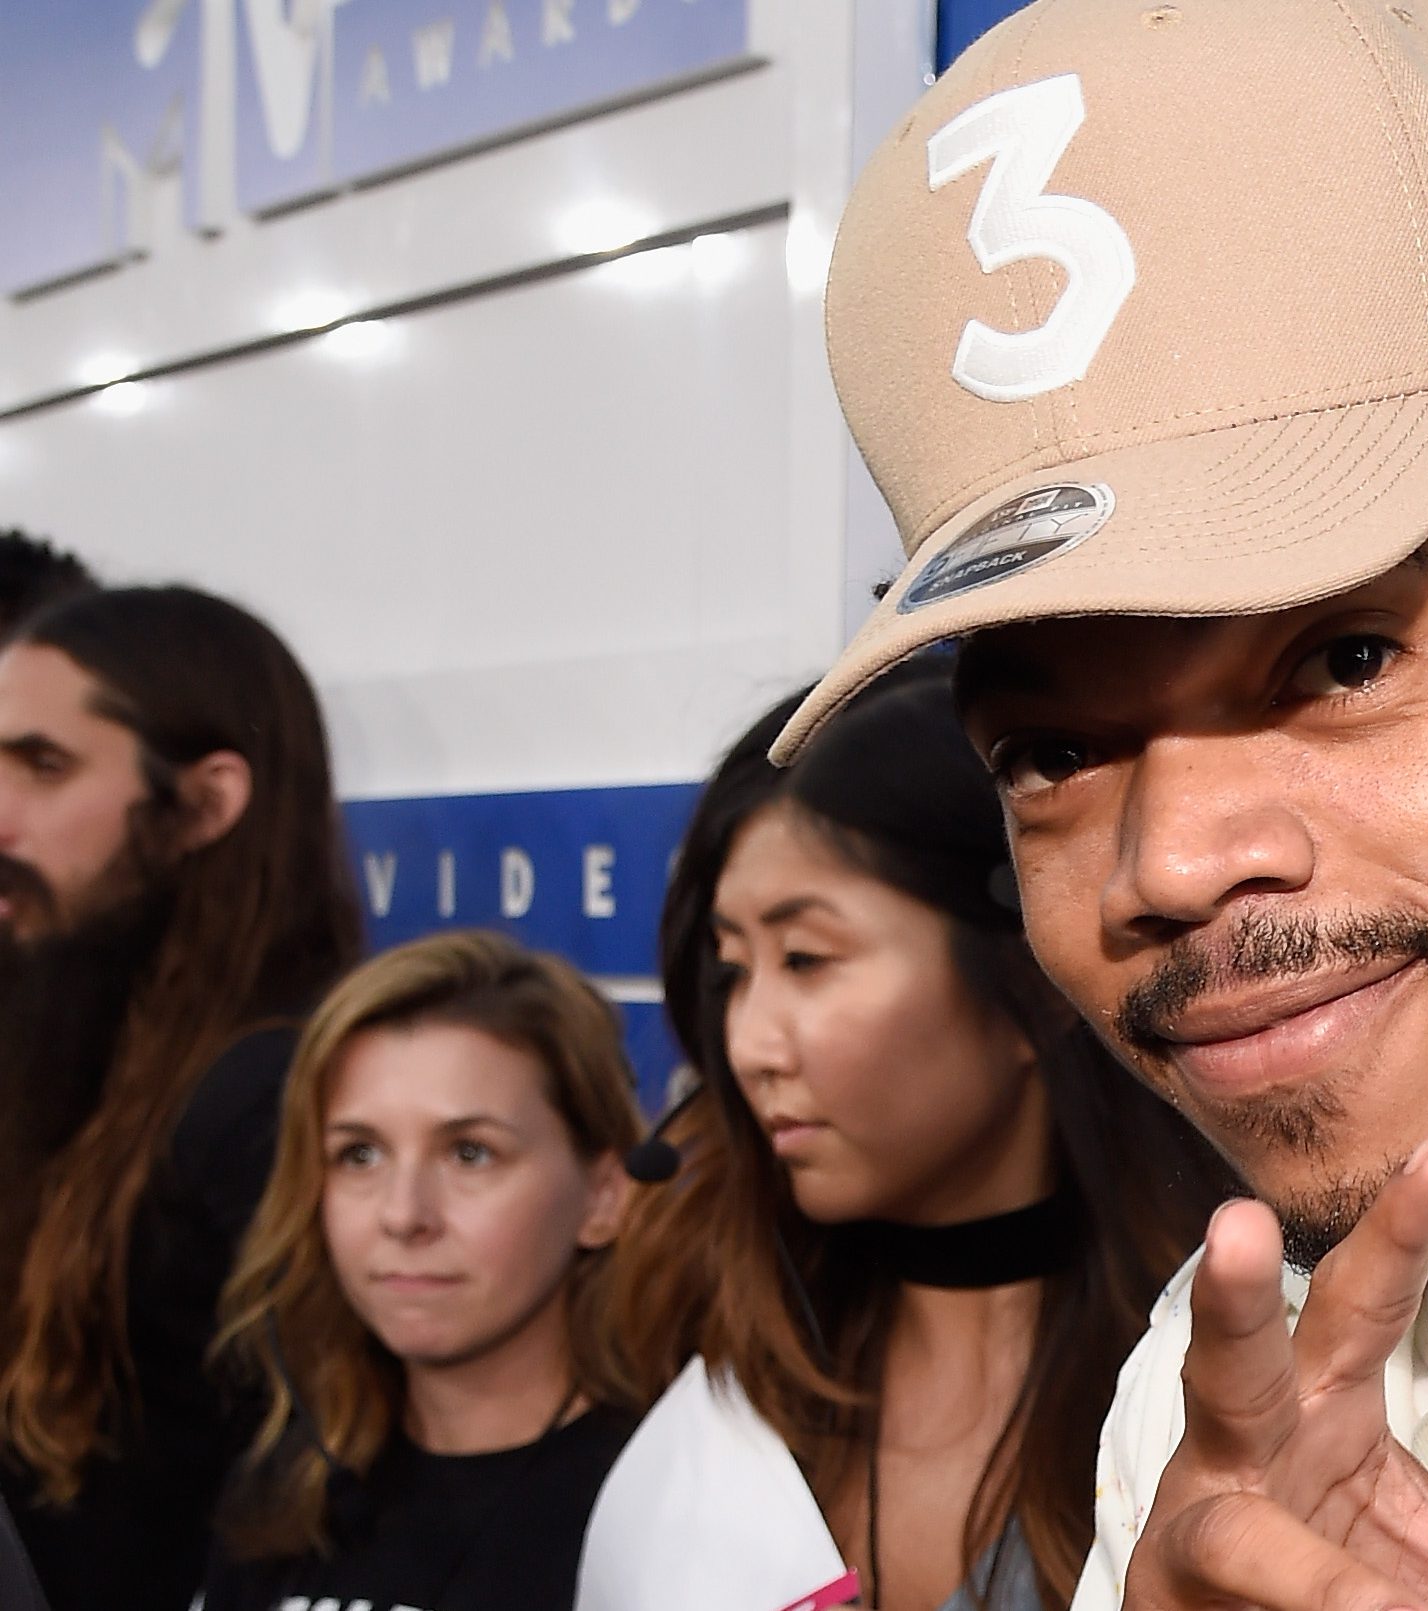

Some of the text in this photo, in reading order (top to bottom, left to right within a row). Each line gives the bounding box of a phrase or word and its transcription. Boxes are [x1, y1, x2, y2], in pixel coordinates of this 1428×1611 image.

[354, 0, 698, 106] AWAR
[927, 72, 1136, 403] 3
[928, 550, 1028, 592] SNAPBACK
[363, 845, 684, 919] VIDE
